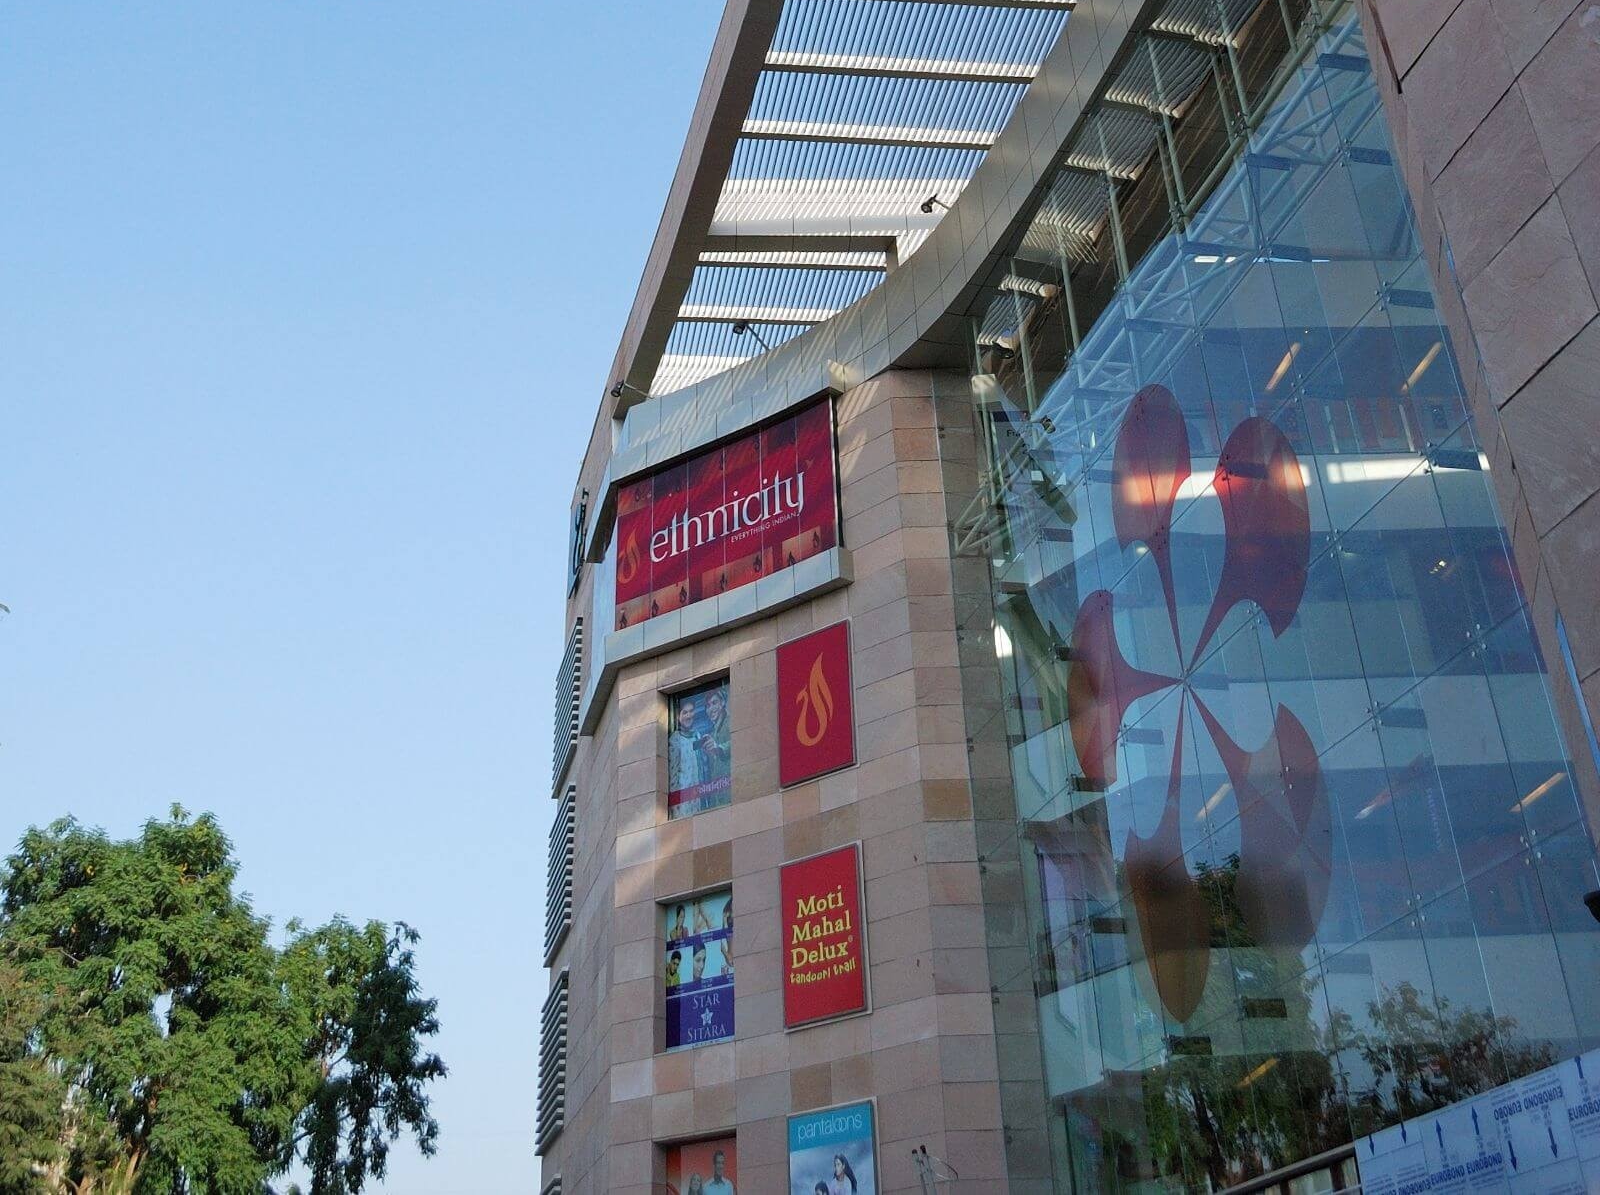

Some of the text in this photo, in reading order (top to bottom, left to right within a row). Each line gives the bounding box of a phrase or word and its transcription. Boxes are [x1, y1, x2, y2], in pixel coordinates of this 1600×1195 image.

[649, 469, 805, 563] ethnicity
[731, 521, 771, 543] EVERYTHING
[796, 884, 844, 918] Moti
[791, 909, 852, 945] Mahal
[789, 966, 831, 984] tandoori
[692, 992, 721, 1010] STAR
[687, 1023, 726, 1042] SITARA
[1568, 1099, 1600, 1123] EUROBO
[797, 1113, 862, 1144] pantaloons
